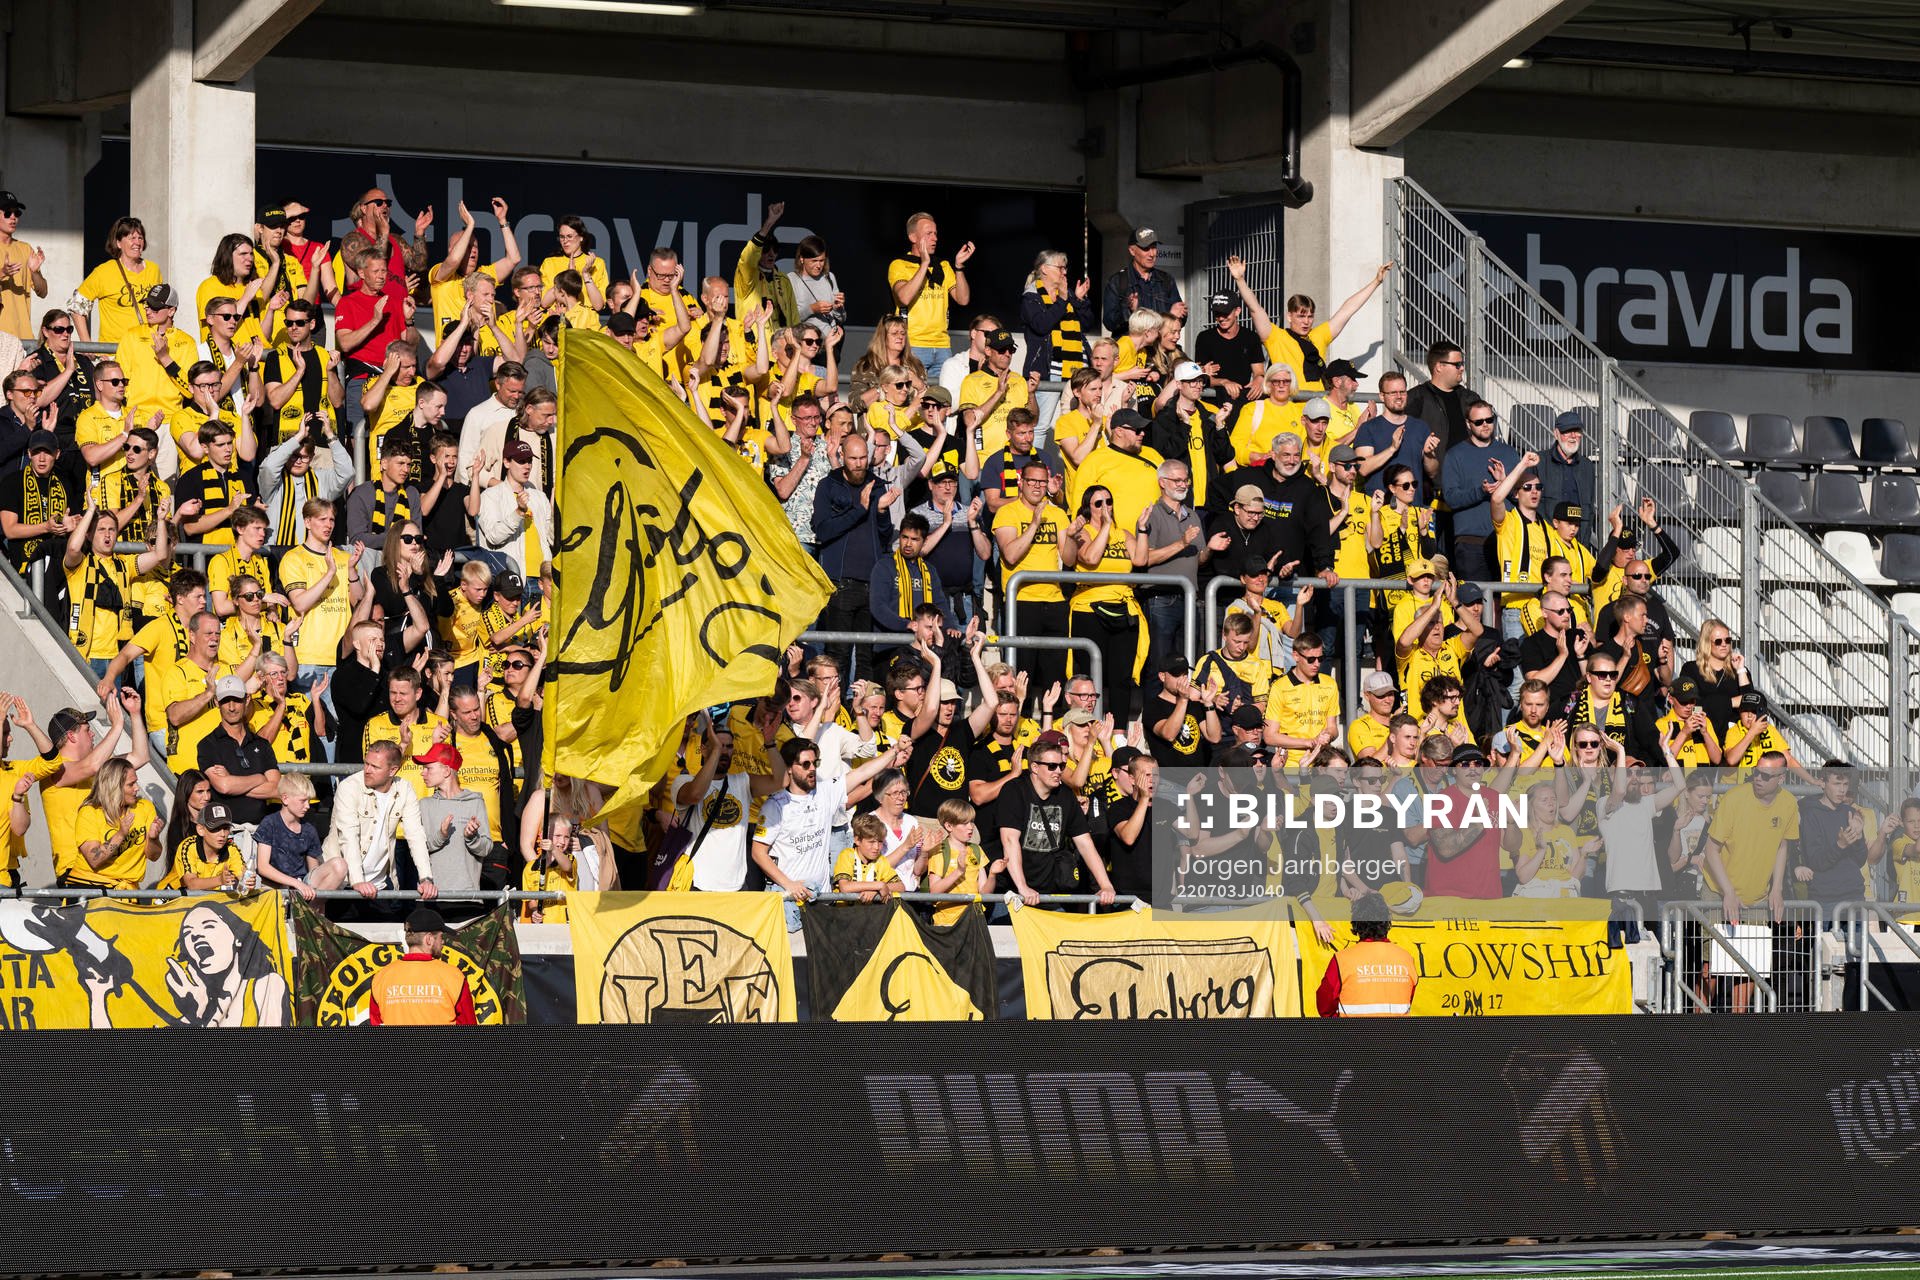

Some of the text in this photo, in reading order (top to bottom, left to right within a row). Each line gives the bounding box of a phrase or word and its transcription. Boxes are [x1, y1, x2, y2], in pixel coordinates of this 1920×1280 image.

[448, 178, 818, 303] brvid
[1156, 249, 1182, 259] ökfritt
[1527, 233, 1852, 354] bravida
[1443, 917, 1480, 931] THE
[1414, 940, 1612, 981] LOWSHIP
[1356, 963, 1410, 977] SECURITY
[386, 984, 443, 997] SECURITY
[1441, 993, 1504, 1010] 20 17
[865, 1070, 1235, 1182] PUMA
